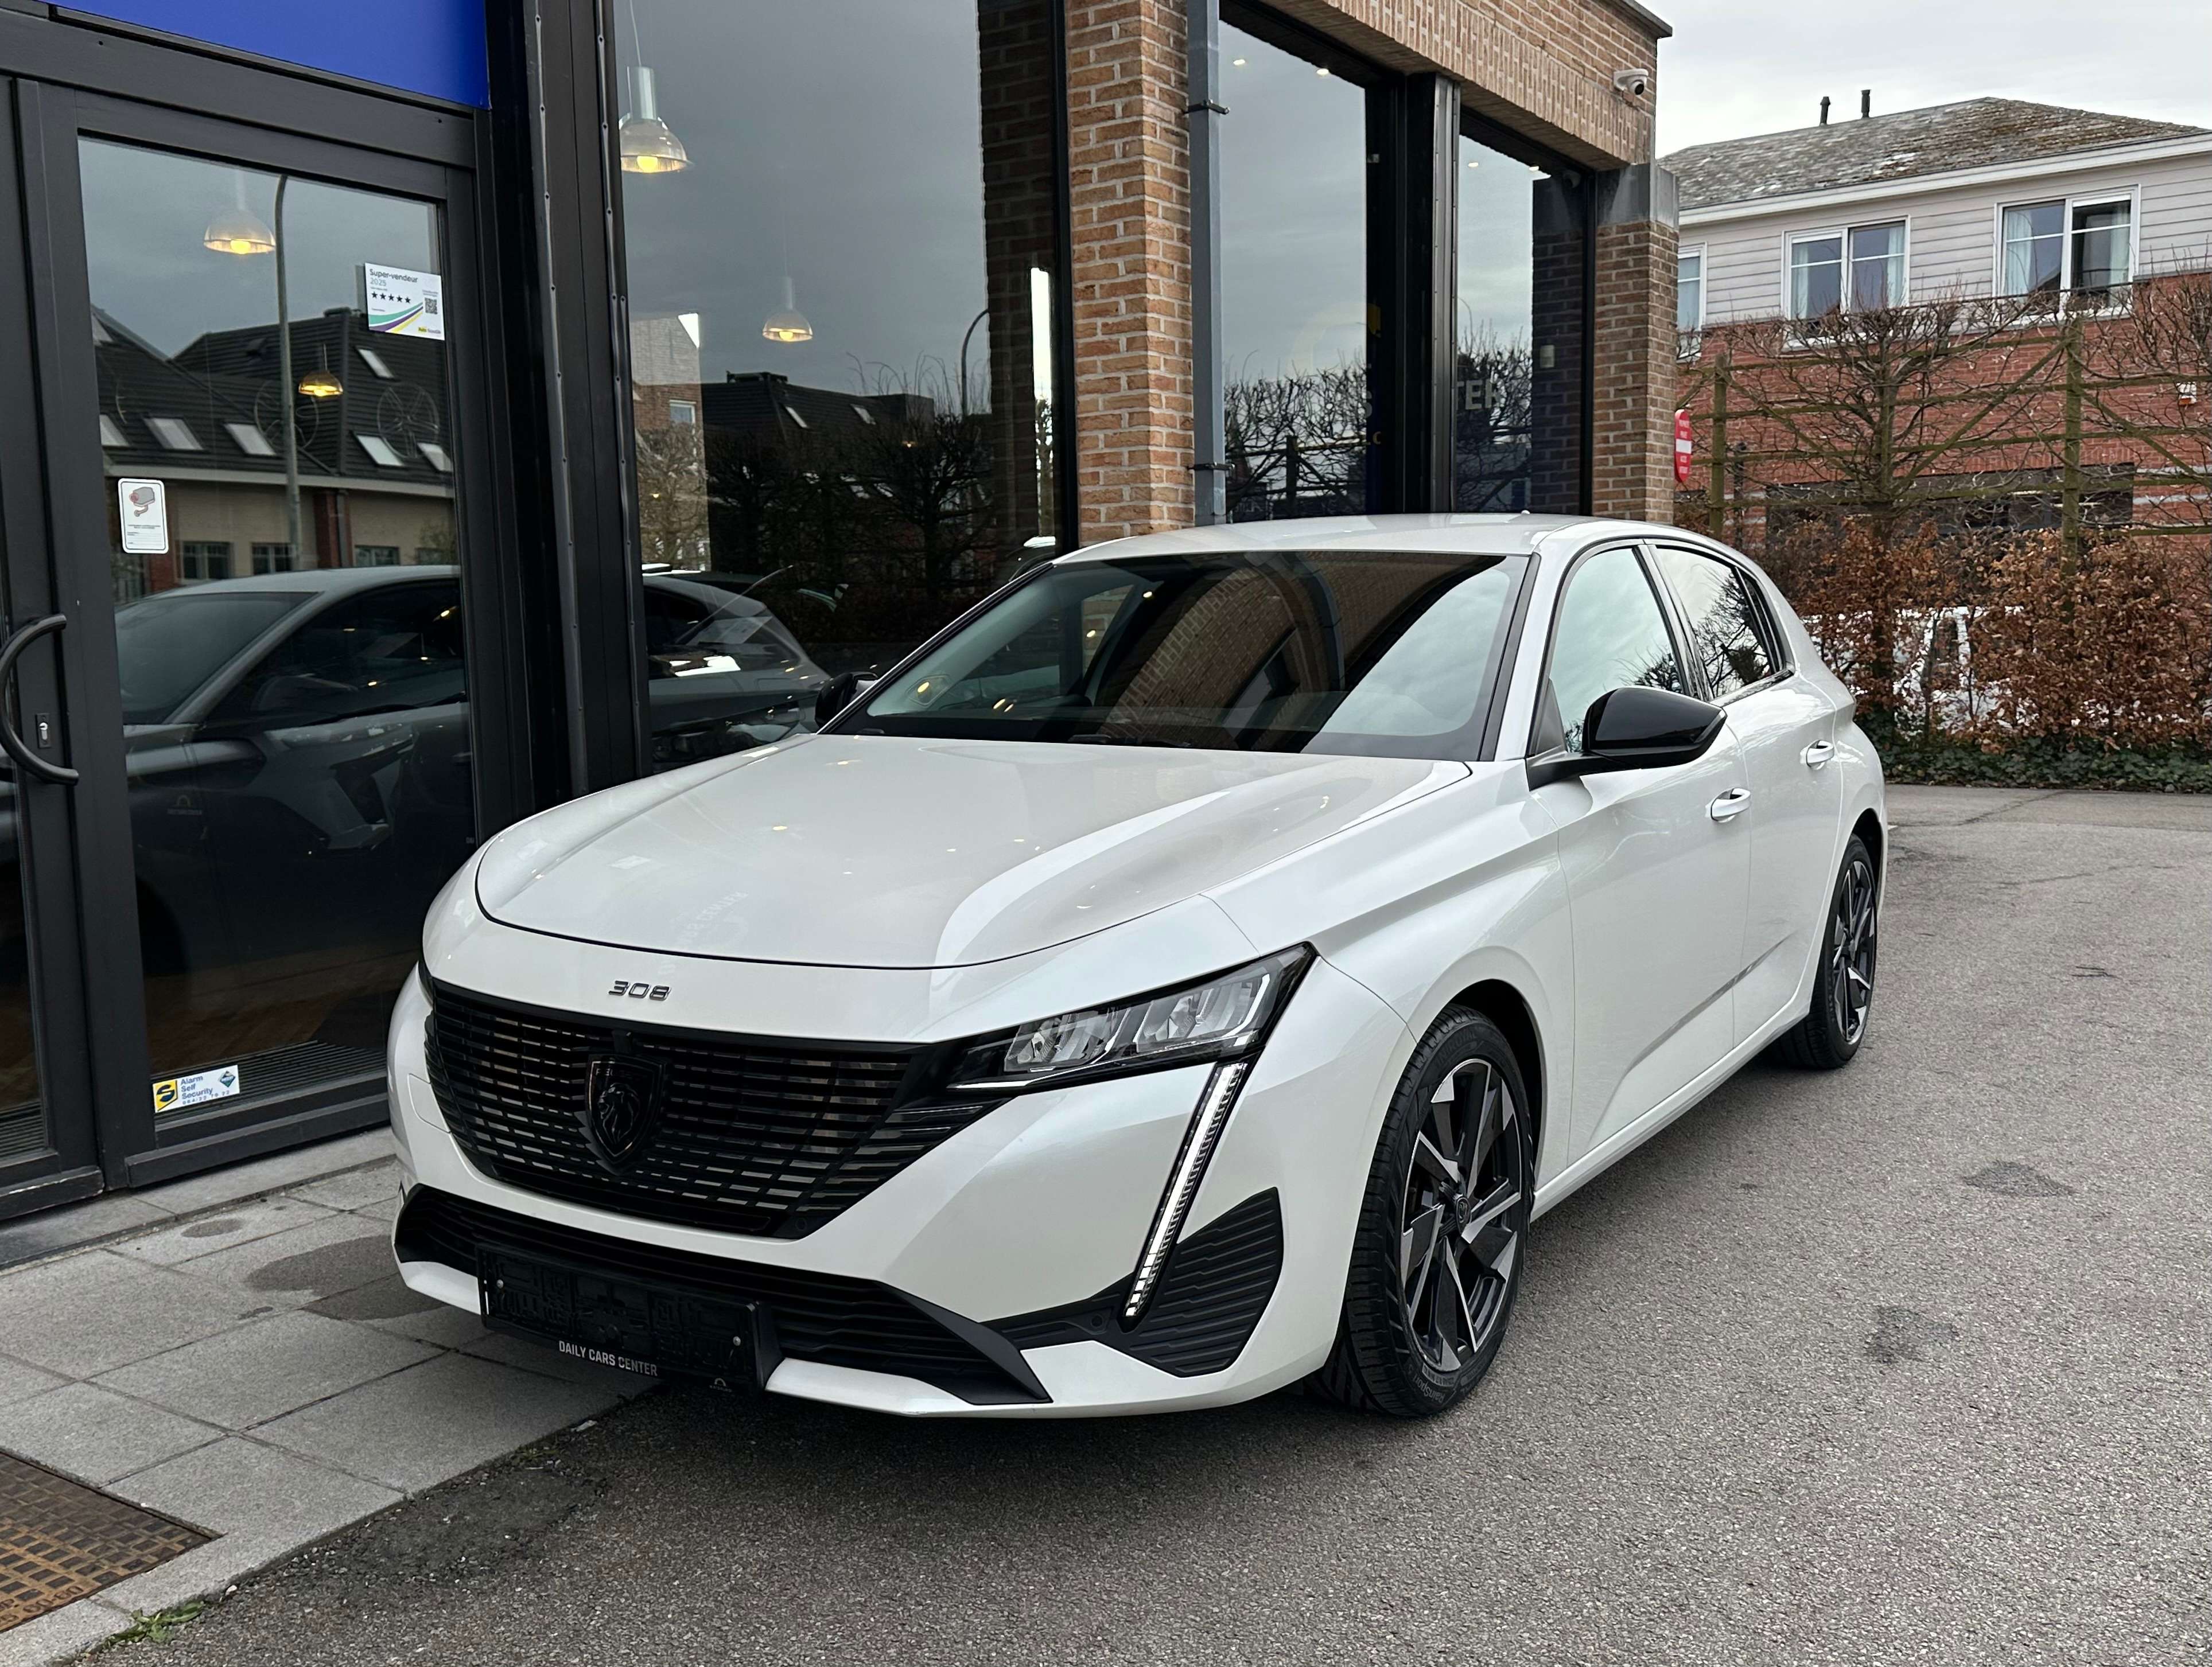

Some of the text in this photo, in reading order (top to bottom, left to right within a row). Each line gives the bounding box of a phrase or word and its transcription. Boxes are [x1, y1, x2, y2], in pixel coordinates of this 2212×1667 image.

[608, 980, 671, 1002] 308
[181, 1076, 203, 1085] Alarm
[181, 1083, 196, 1092] Self
[181, 1088, 213, 1100] Security
[559, 1340, 658, 1376] DAILY CARS CENTER
